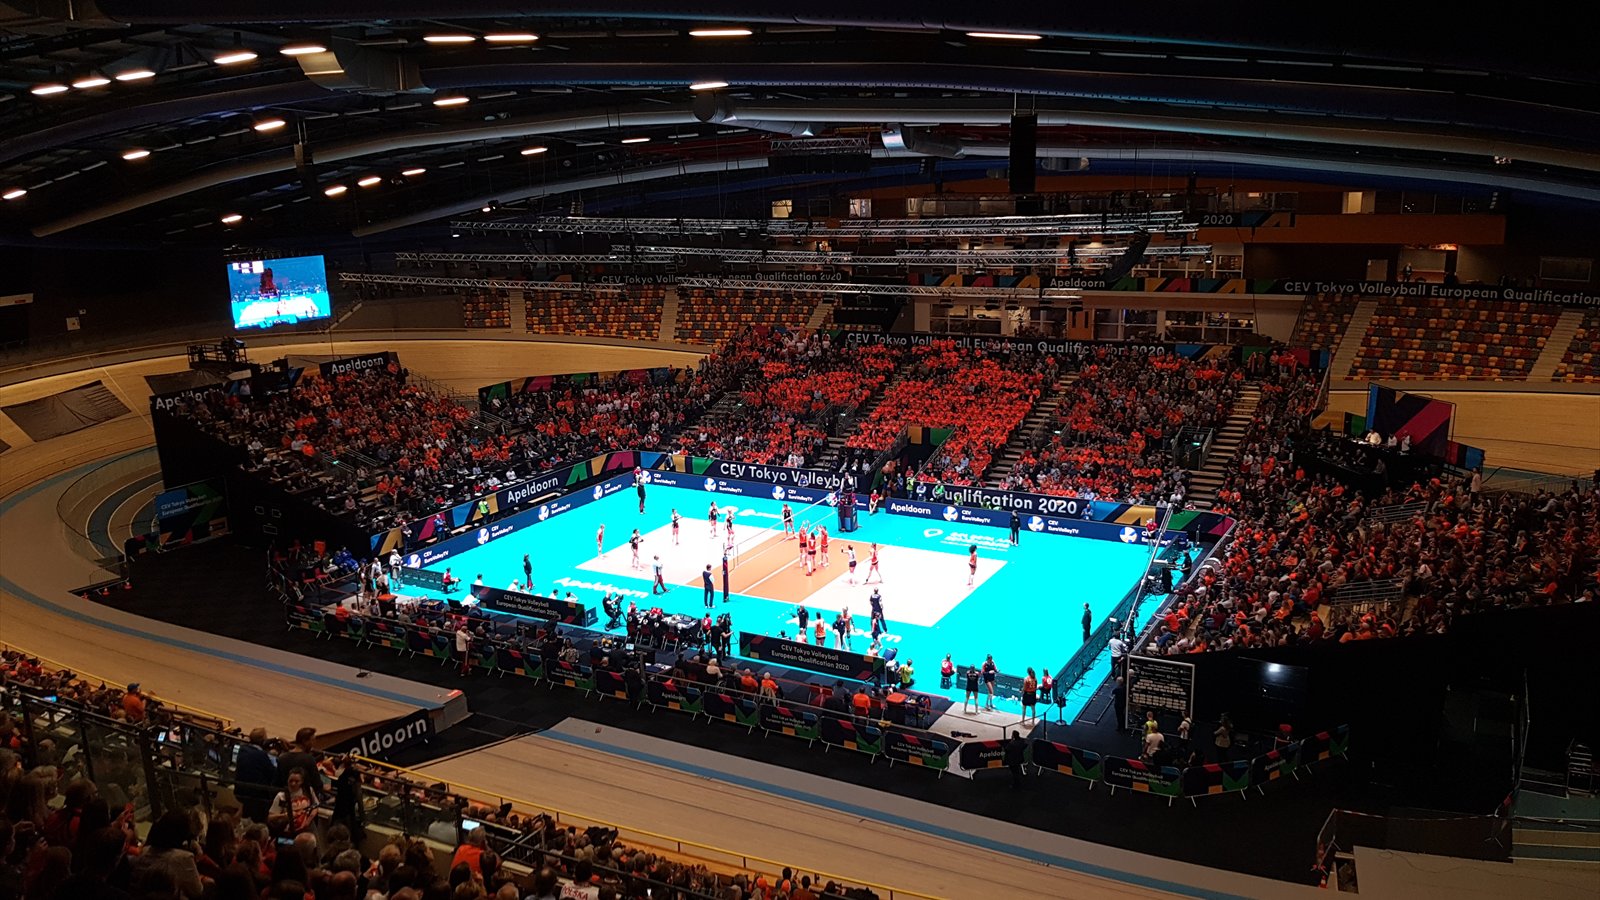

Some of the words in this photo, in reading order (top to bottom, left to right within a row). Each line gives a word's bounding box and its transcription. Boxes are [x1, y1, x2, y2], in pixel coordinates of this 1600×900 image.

[1203, 215, 1233, 225] 2020
[601, 275, 621, 284] CEV
[624, 274, 653, 285] Tokyo
[755, 271, 817, 281] Qualification
[1050, 277, 1106, 289] Apeldoorn
[1284, 281, 1311, 292] CEV
[1315, 282, 1354, 294] Tokyo
[1358, 282, 1426, 297] Volleyball
[1431, 285, 1498, 299] European
[1503, 288, 1600, 305] Qualification
[847, 332, 870, 344] CEV
[873, 334, 907, 346] Tokyo
[911, 336, 970, 349] Vollall
[720, 463, 745, 476] CEV
[749, 466, 787, 483] Tokyo
[507, 477, 559, 504] Apeldoorn
[890, 502, 931, 515] Apeldoorn
[1038, 498, 1077, 515] 2020
[771, 650, 797, 660] European
[798, 655, 834, 668] Qualification
[835, 663, 850, 671] 2020
[781, 644, 792, 652] CEV
[794, 646, 810, 656] Tokyo
[811, 650, 839, 661] Volleyball
